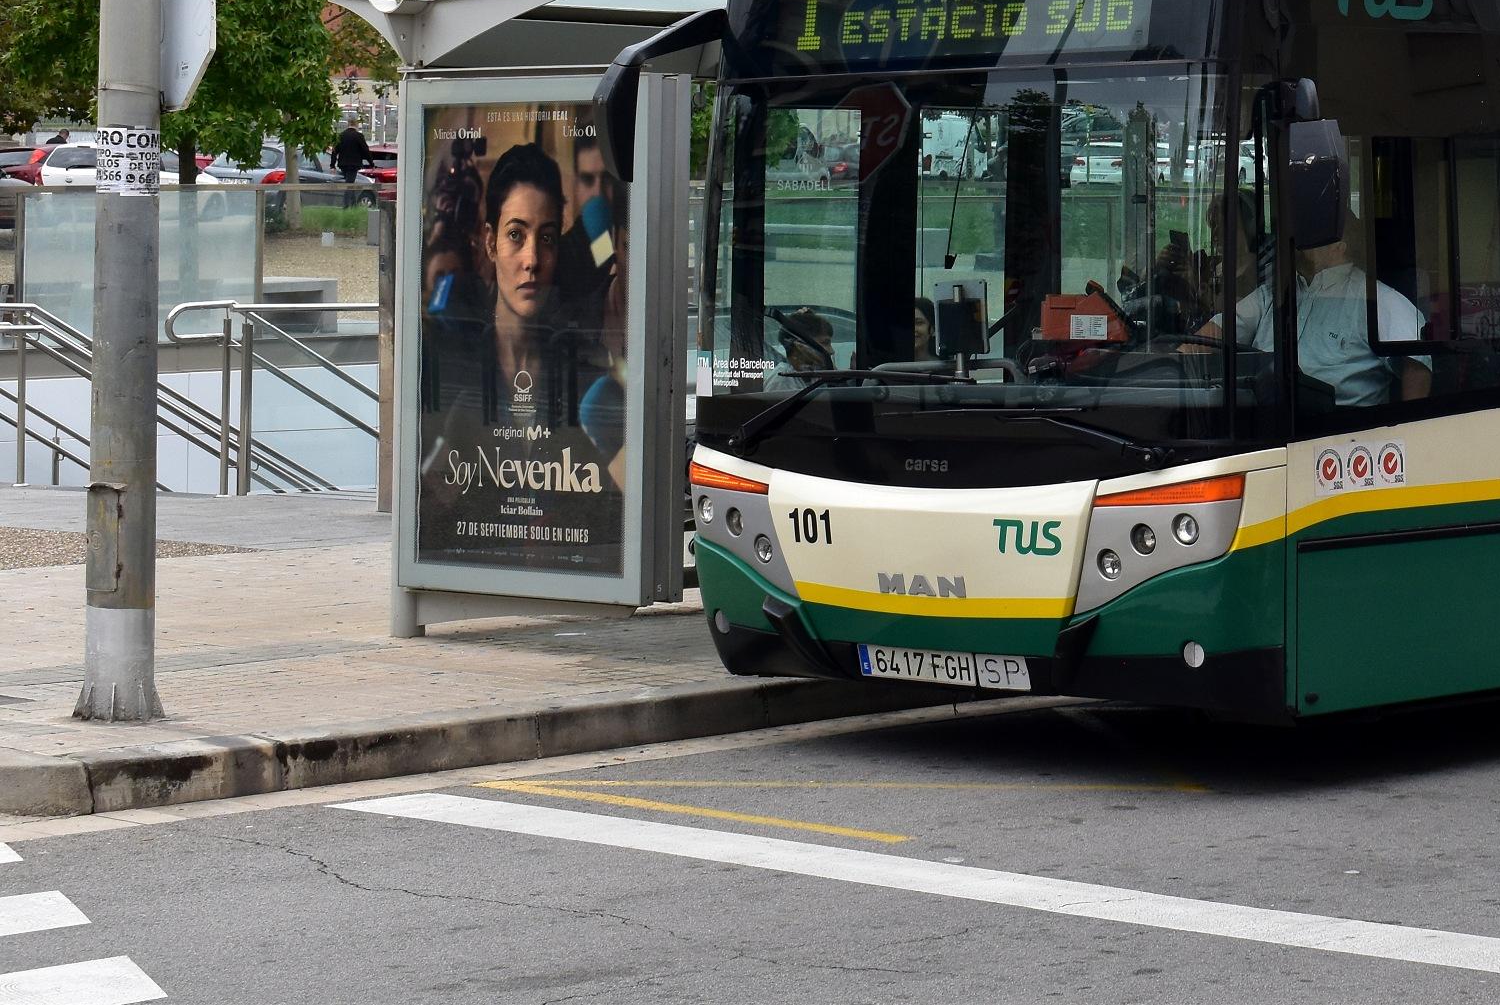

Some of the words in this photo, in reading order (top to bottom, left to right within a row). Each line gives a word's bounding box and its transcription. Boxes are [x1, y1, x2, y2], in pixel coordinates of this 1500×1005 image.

[842, 2, 1028, 45] ESTACIO
[552, 110, 568, 121] REAL
[458, 127, 481, 139] Oriol
[563, 125, 584, 138] Urko
[777, 180, 834, 191] SABADELL
[713, 354, 729, 369] Àrea
[729, 357, 739, 369] de
[740, 357, 775, 370] Barcelona
[741, 371, 764, 380] Transport
[513, 393, 533, 403] SSIFF
[493, 426, 525, 440] original
[445, 449, 478, 494] Soy
[477, 446, 603, 493] Nevenka
[905, 458, 949, 472] carsa
[456, 521, 466, 536] 27
[469, 522, 478, 536] DE
[480, 522, 528, 539] SEPTIEMBRE
[531, 526, 550, 541] SOLO
[552, 527, 563, 542] EN
[565, 528, 589, 543] CINES
[789, 508, 832, 544] 101
[993, 518, 1062, 556] TUS
[877, 572, 967, 598] MAN
[875, 649, 925, 677] 6417
[931, 654, 972, 682] FGH
[984, 658, 1020, 686] SP
